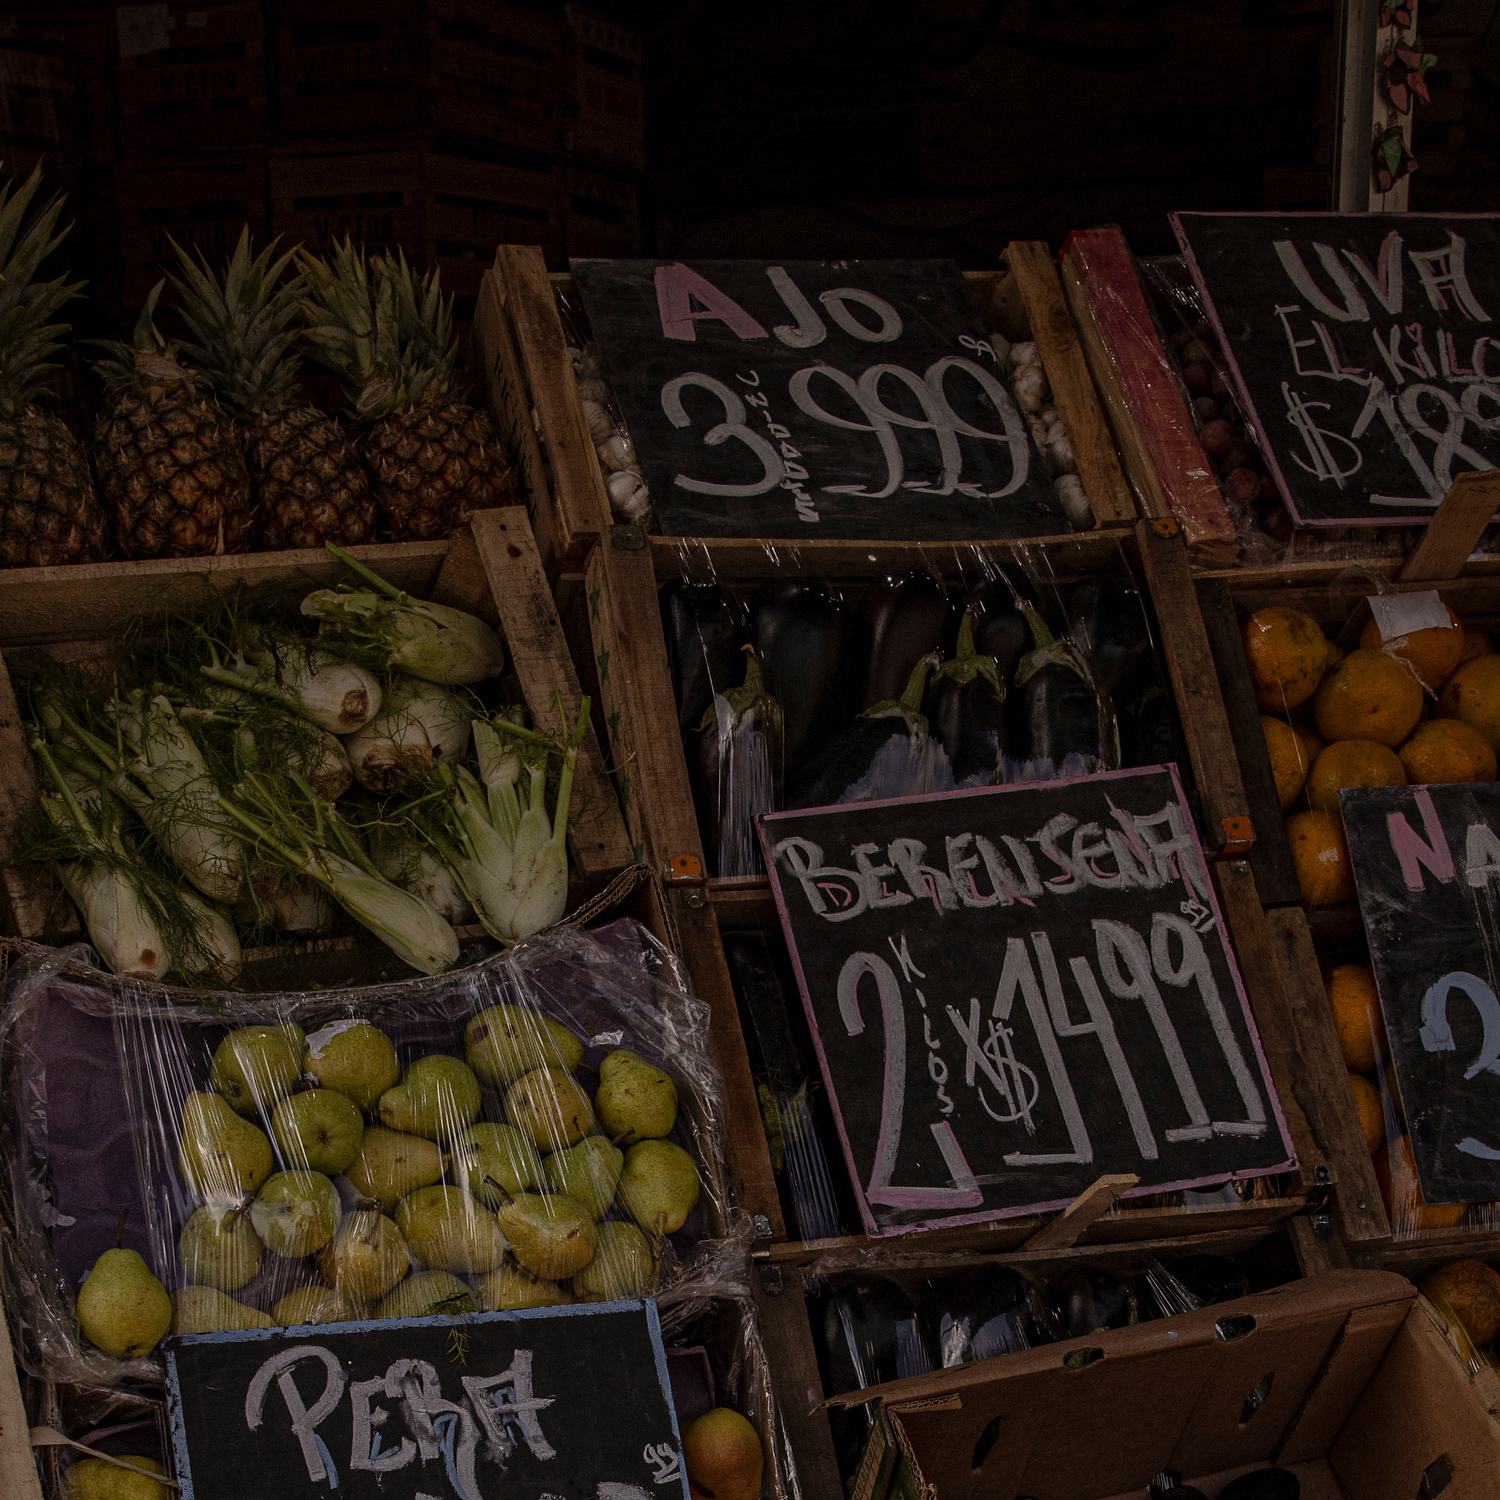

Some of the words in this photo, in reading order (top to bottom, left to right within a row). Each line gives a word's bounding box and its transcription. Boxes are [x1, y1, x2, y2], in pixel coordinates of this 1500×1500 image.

[148, 223, 226, 257] VCTOR
[313, 214, 394, 245] VCTOR
[654, 262, 903, 347] AJO
[1272, 229, 1493, 322] UVA
[1274, 303, 1374, 386] EL
[660, 370, 785, 496] 3
[788, 356, 1030, 499] 999
